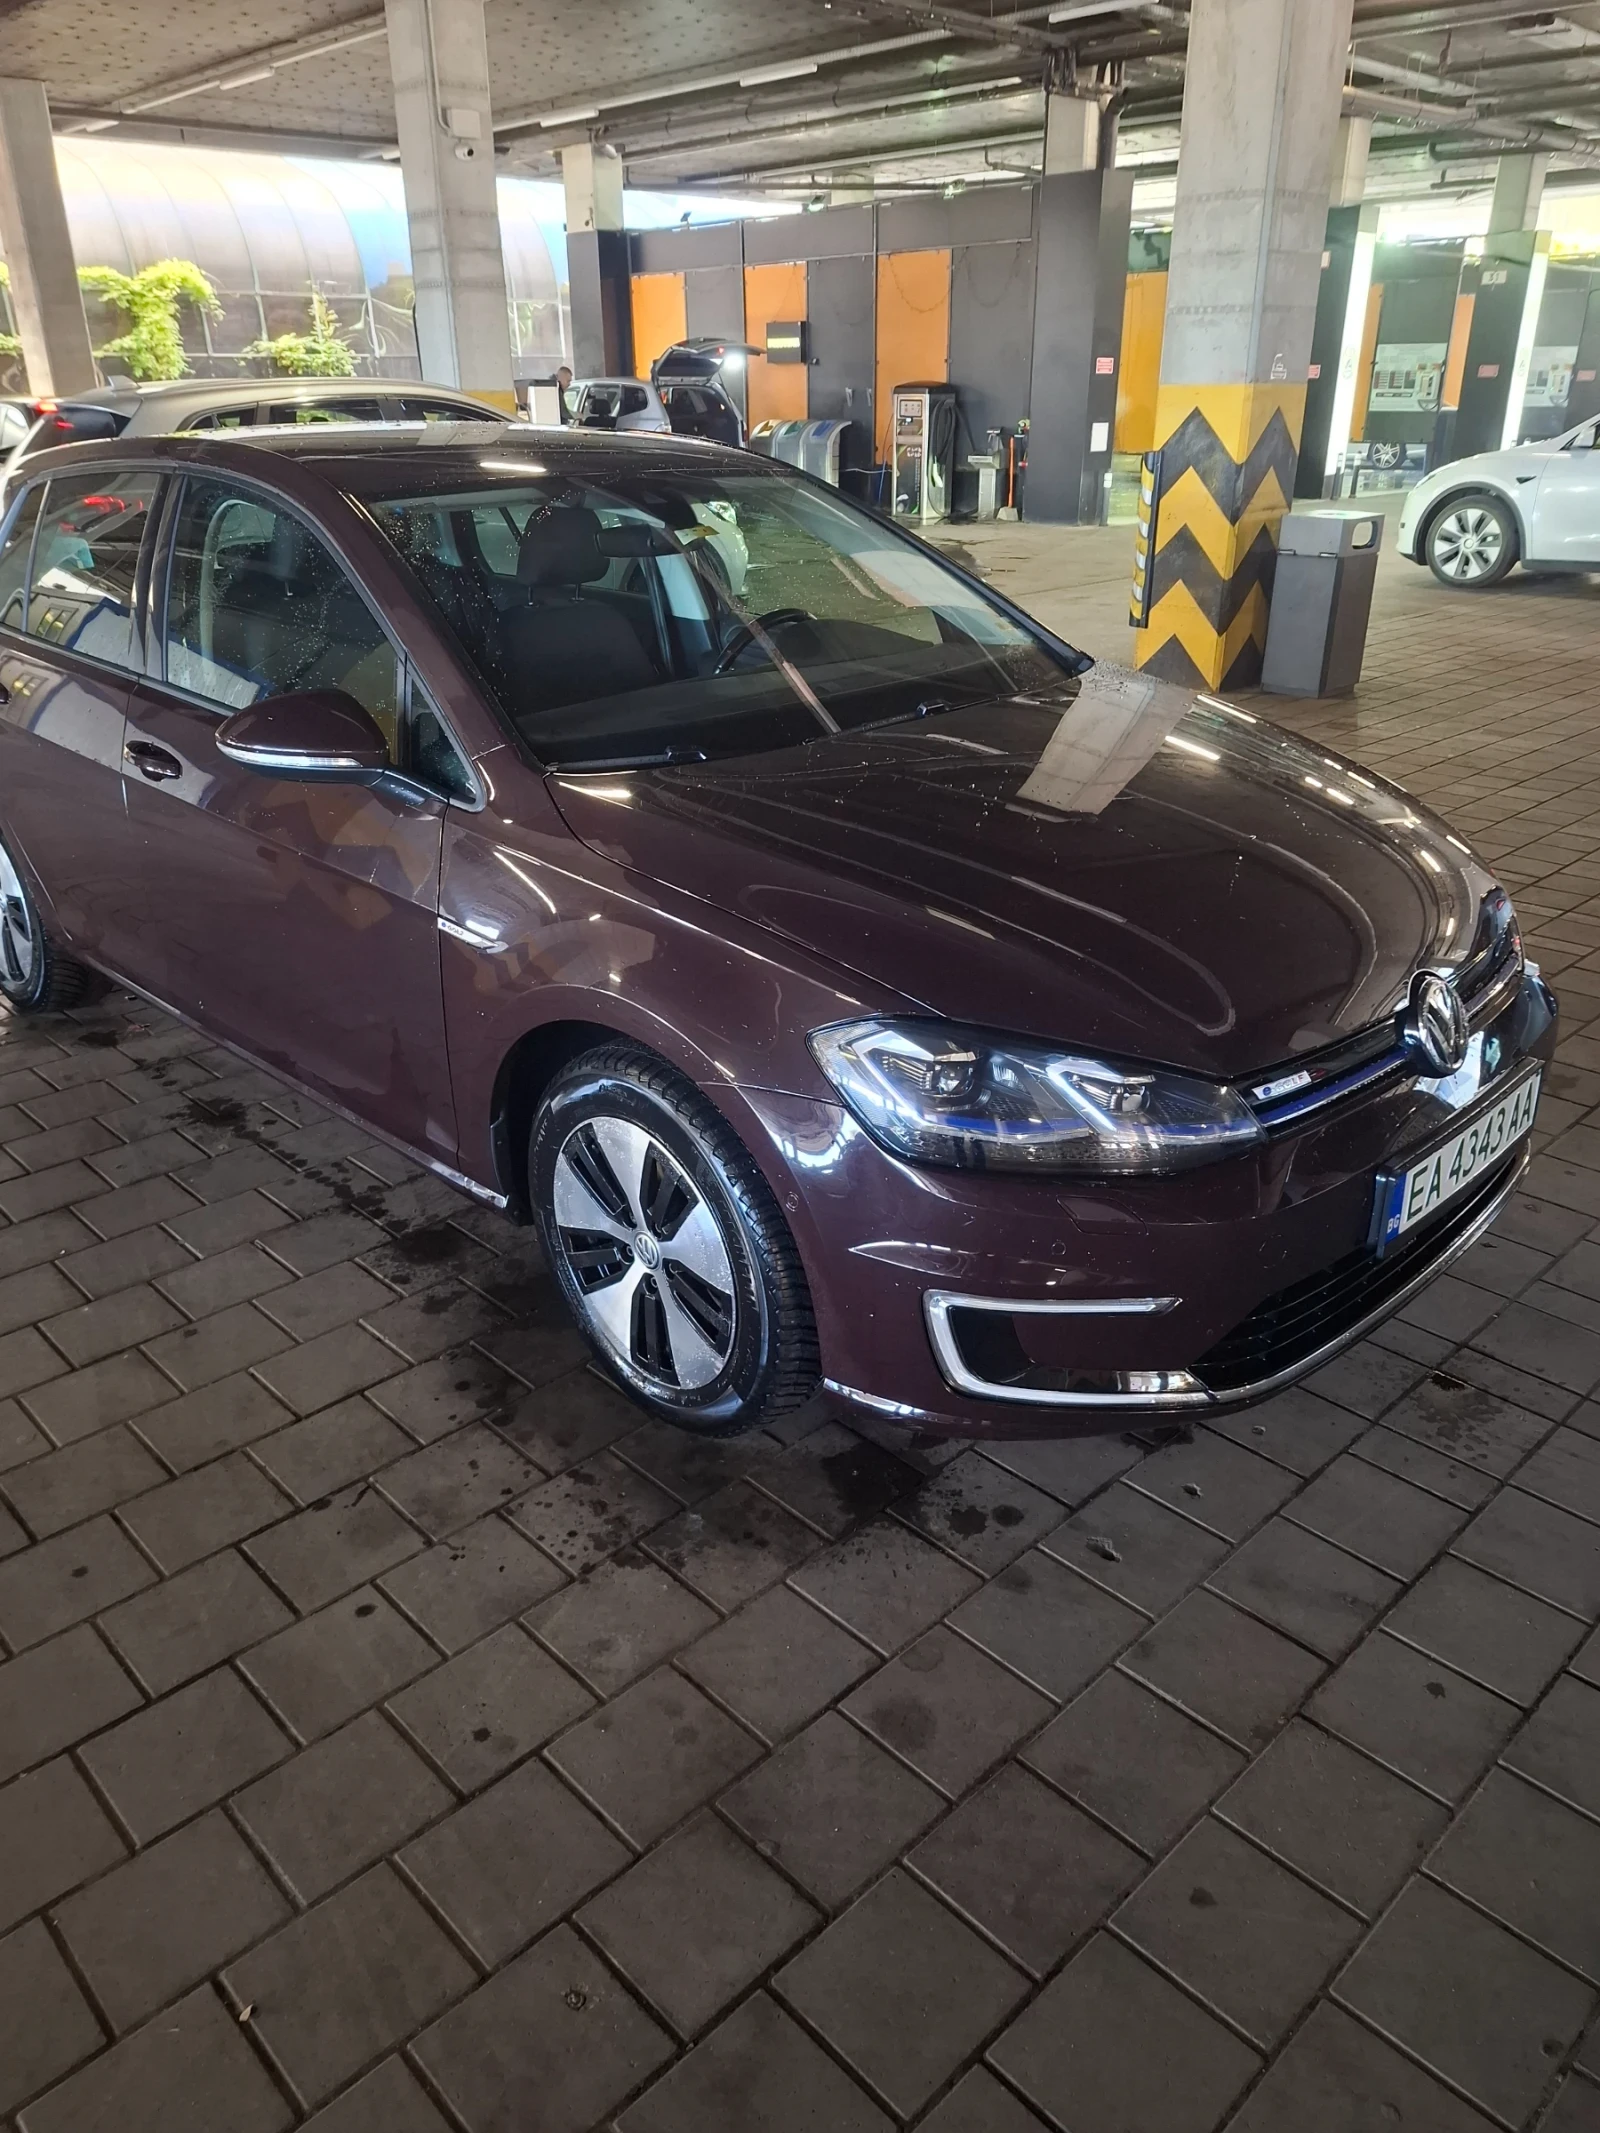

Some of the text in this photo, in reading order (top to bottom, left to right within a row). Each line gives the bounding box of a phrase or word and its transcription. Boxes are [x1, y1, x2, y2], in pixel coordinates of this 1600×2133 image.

[1406, 1081, 1534, 1222] EA 4343 AA
[1386, 1214, 1400, 1234] BG
